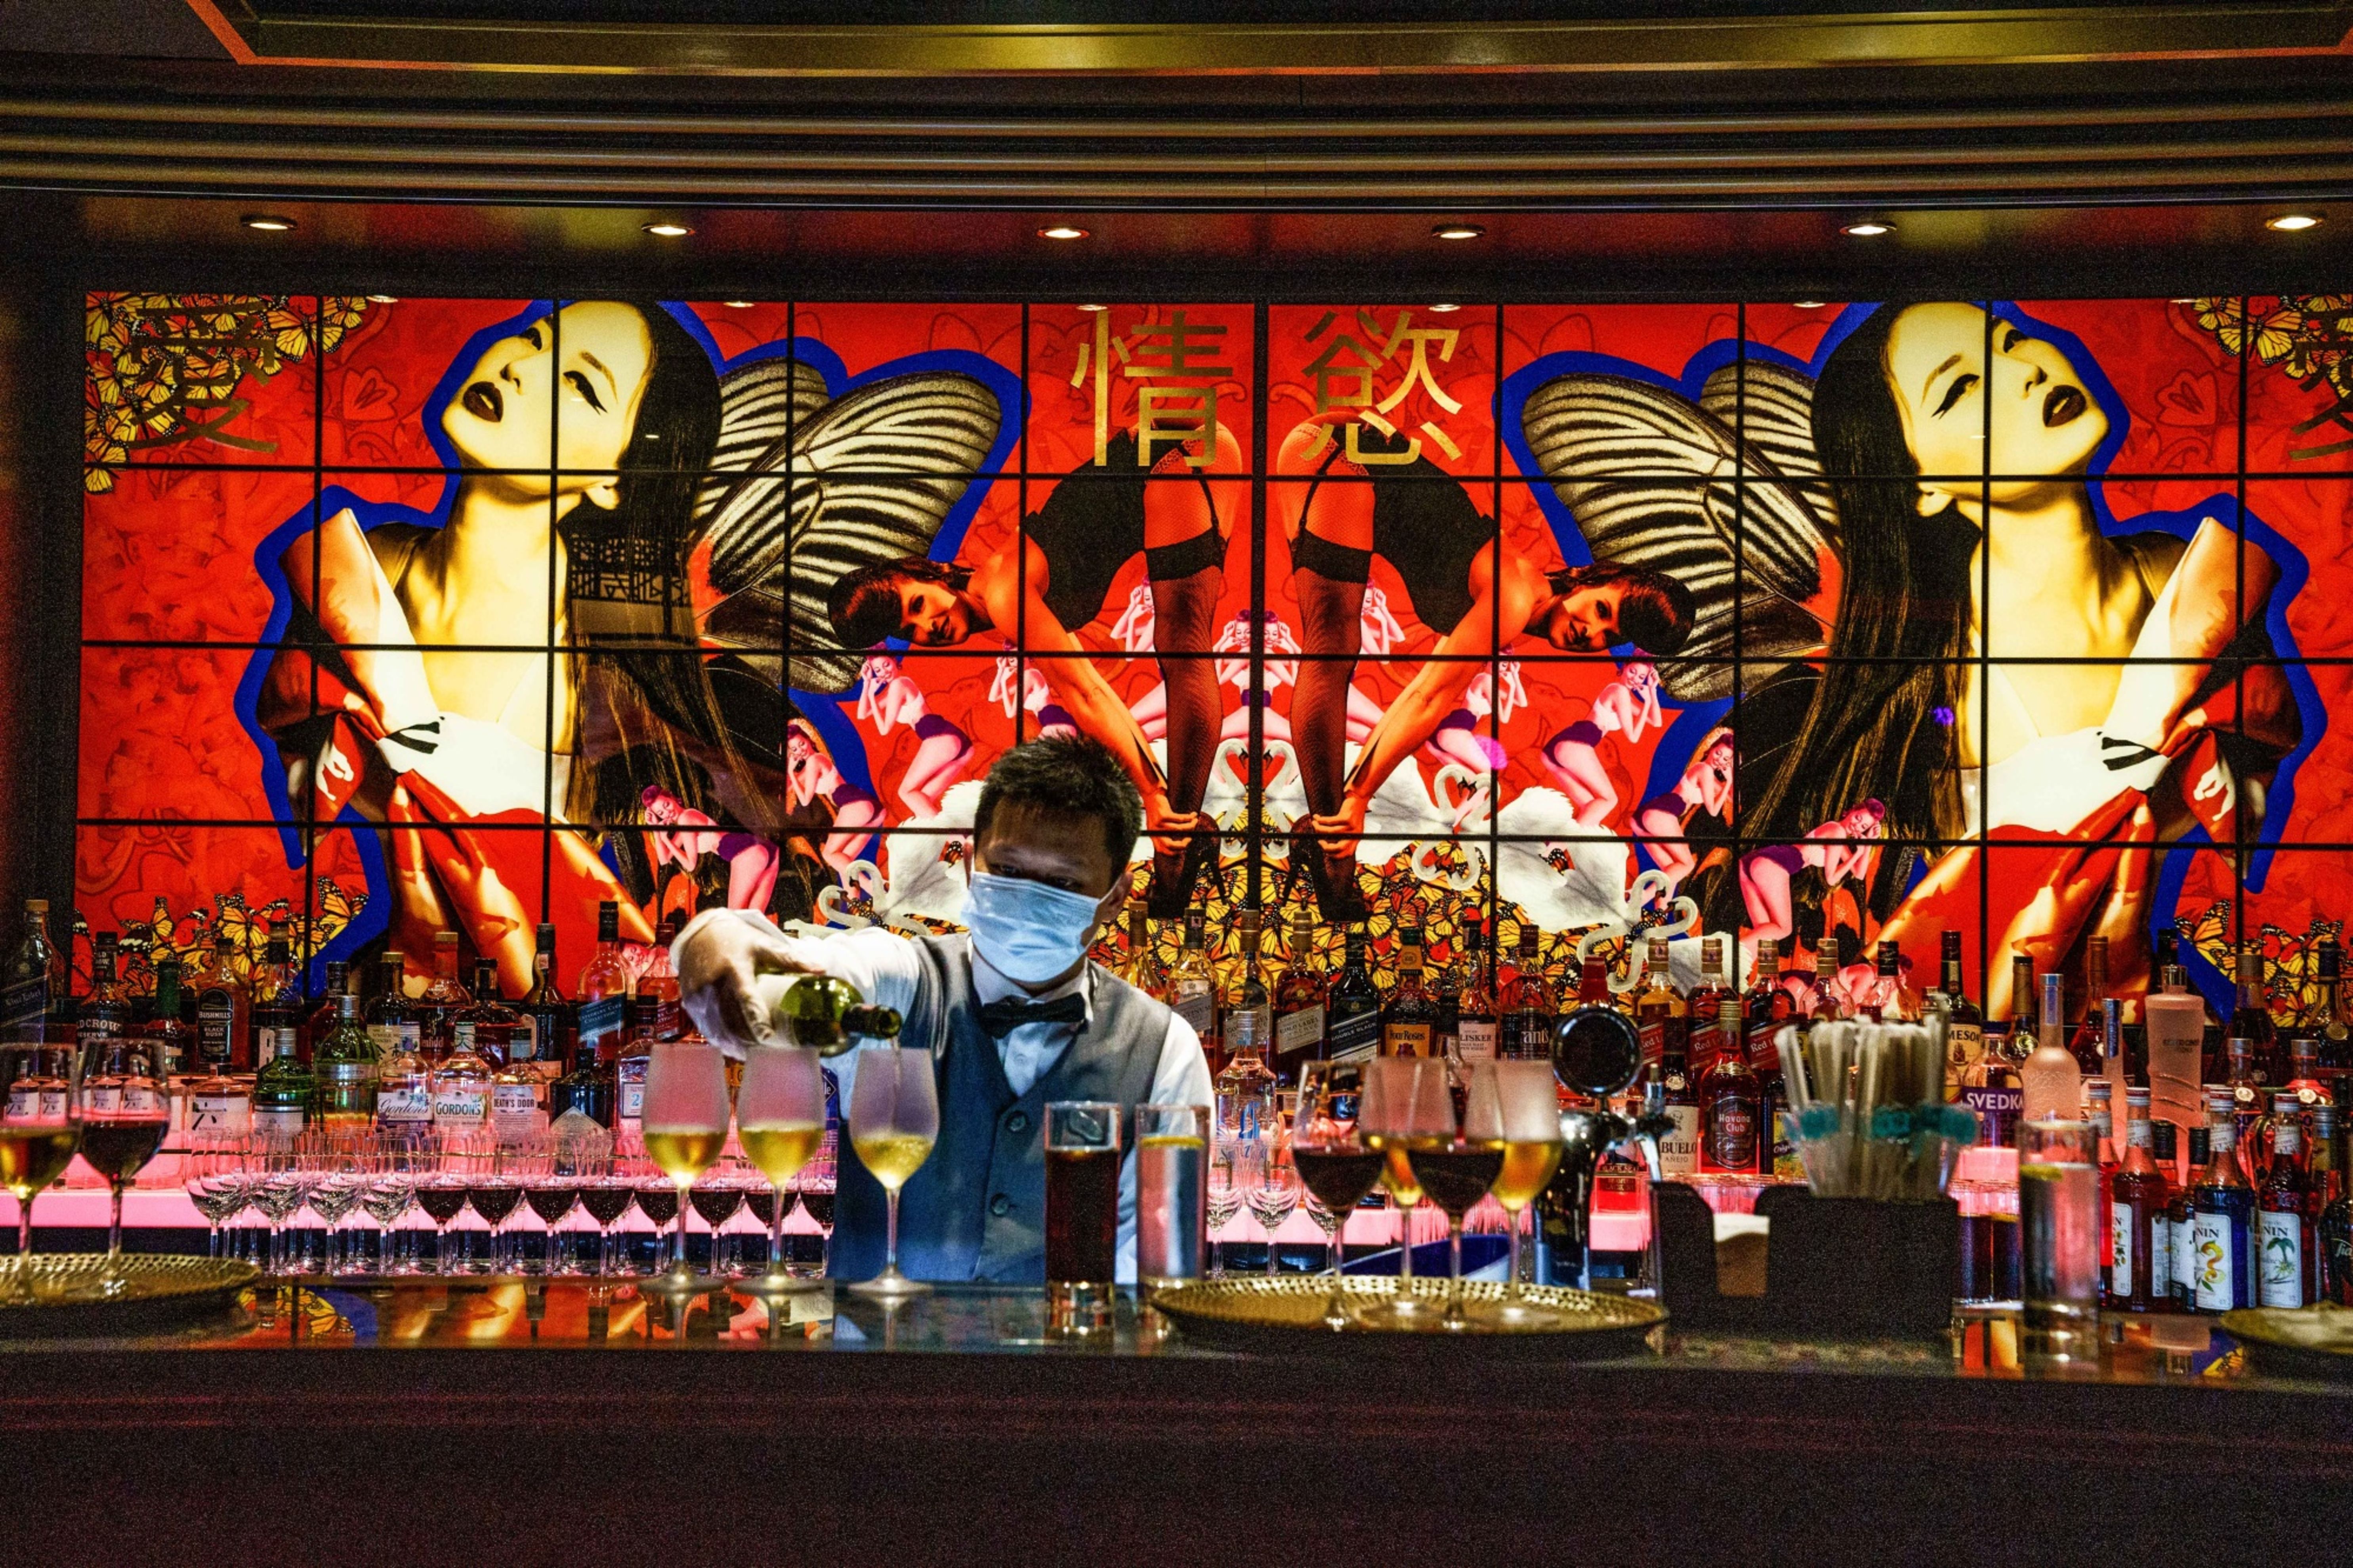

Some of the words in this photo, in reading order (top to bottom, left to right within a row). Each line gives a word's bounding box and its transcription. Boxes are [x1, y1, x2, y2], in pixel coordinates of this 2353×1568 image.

[1404, 1030, 1425, 1040] Roses
[1750, 1040, 1767, 1052] Red
[436, 1102, 481, 1115] GORDON'S
[494, 1099, 515, 1107] DEATH'S
[517, 1099, 535, 1108] DOOR
[1718, 1113, 1751, 1123] Havana
[1725, 1123, 1745, 1132] Club
[1664, 1154, 1689, 1163] AÑEJO
